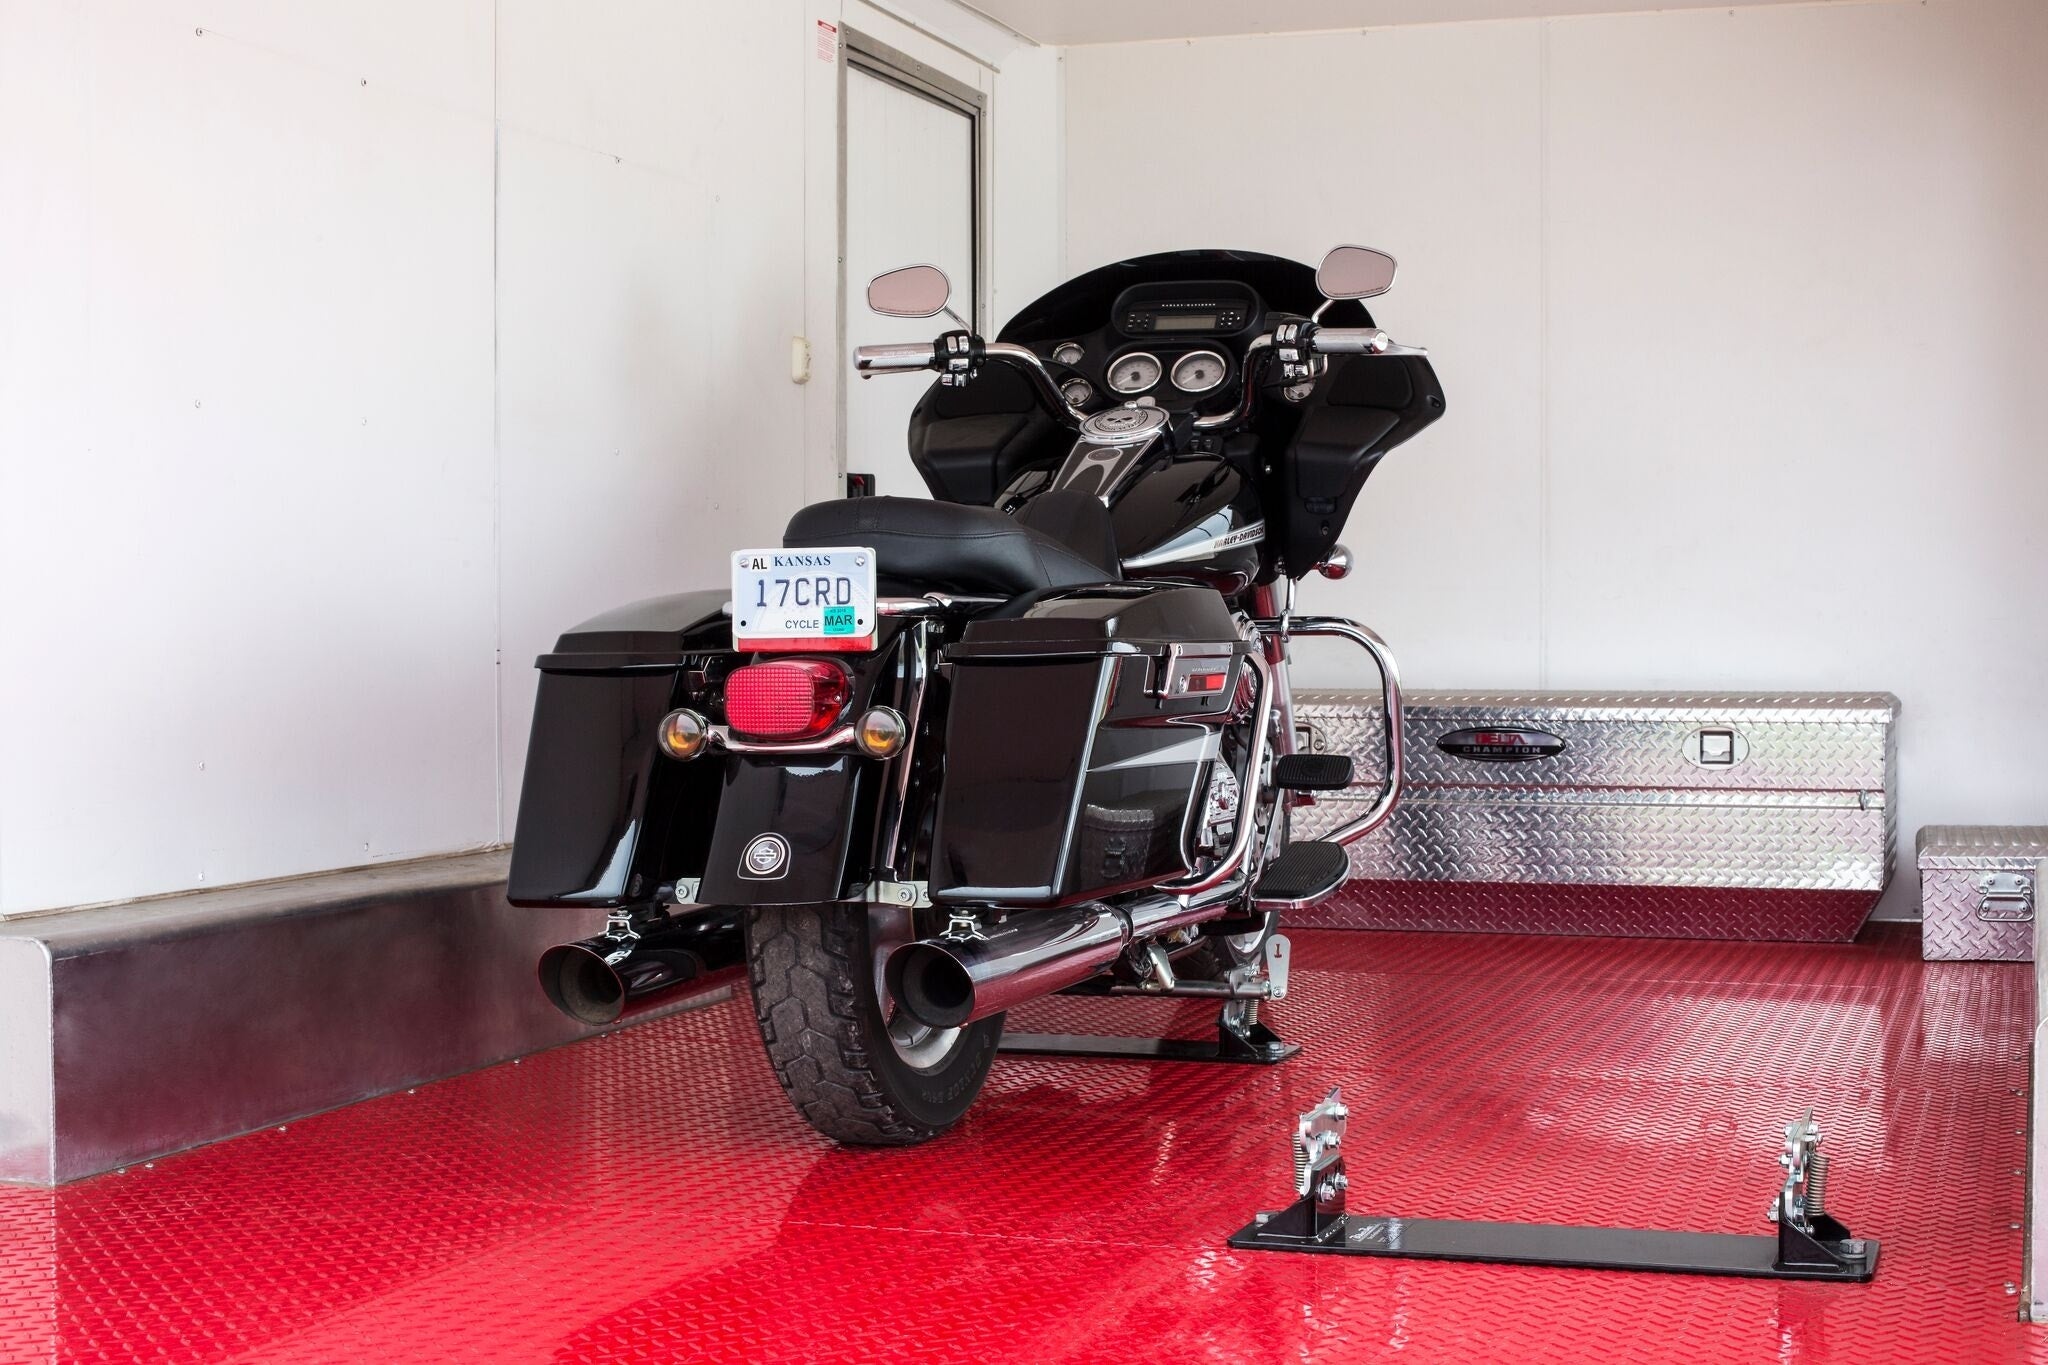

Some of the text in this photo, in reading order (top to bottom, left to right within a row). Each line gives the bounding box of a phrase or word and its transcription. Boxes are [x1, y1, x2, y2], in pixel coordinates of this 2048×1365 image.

[752, 558, 768, 570] AL
[774, 555, 831, 567] KANSAS
[756, 576, 851, 608] 17CRD
[785, 619, 820, 629] CYCLE
[824, 614, 853, 627] MAR
[1463, 746, 1541, 754] CHAMPION
